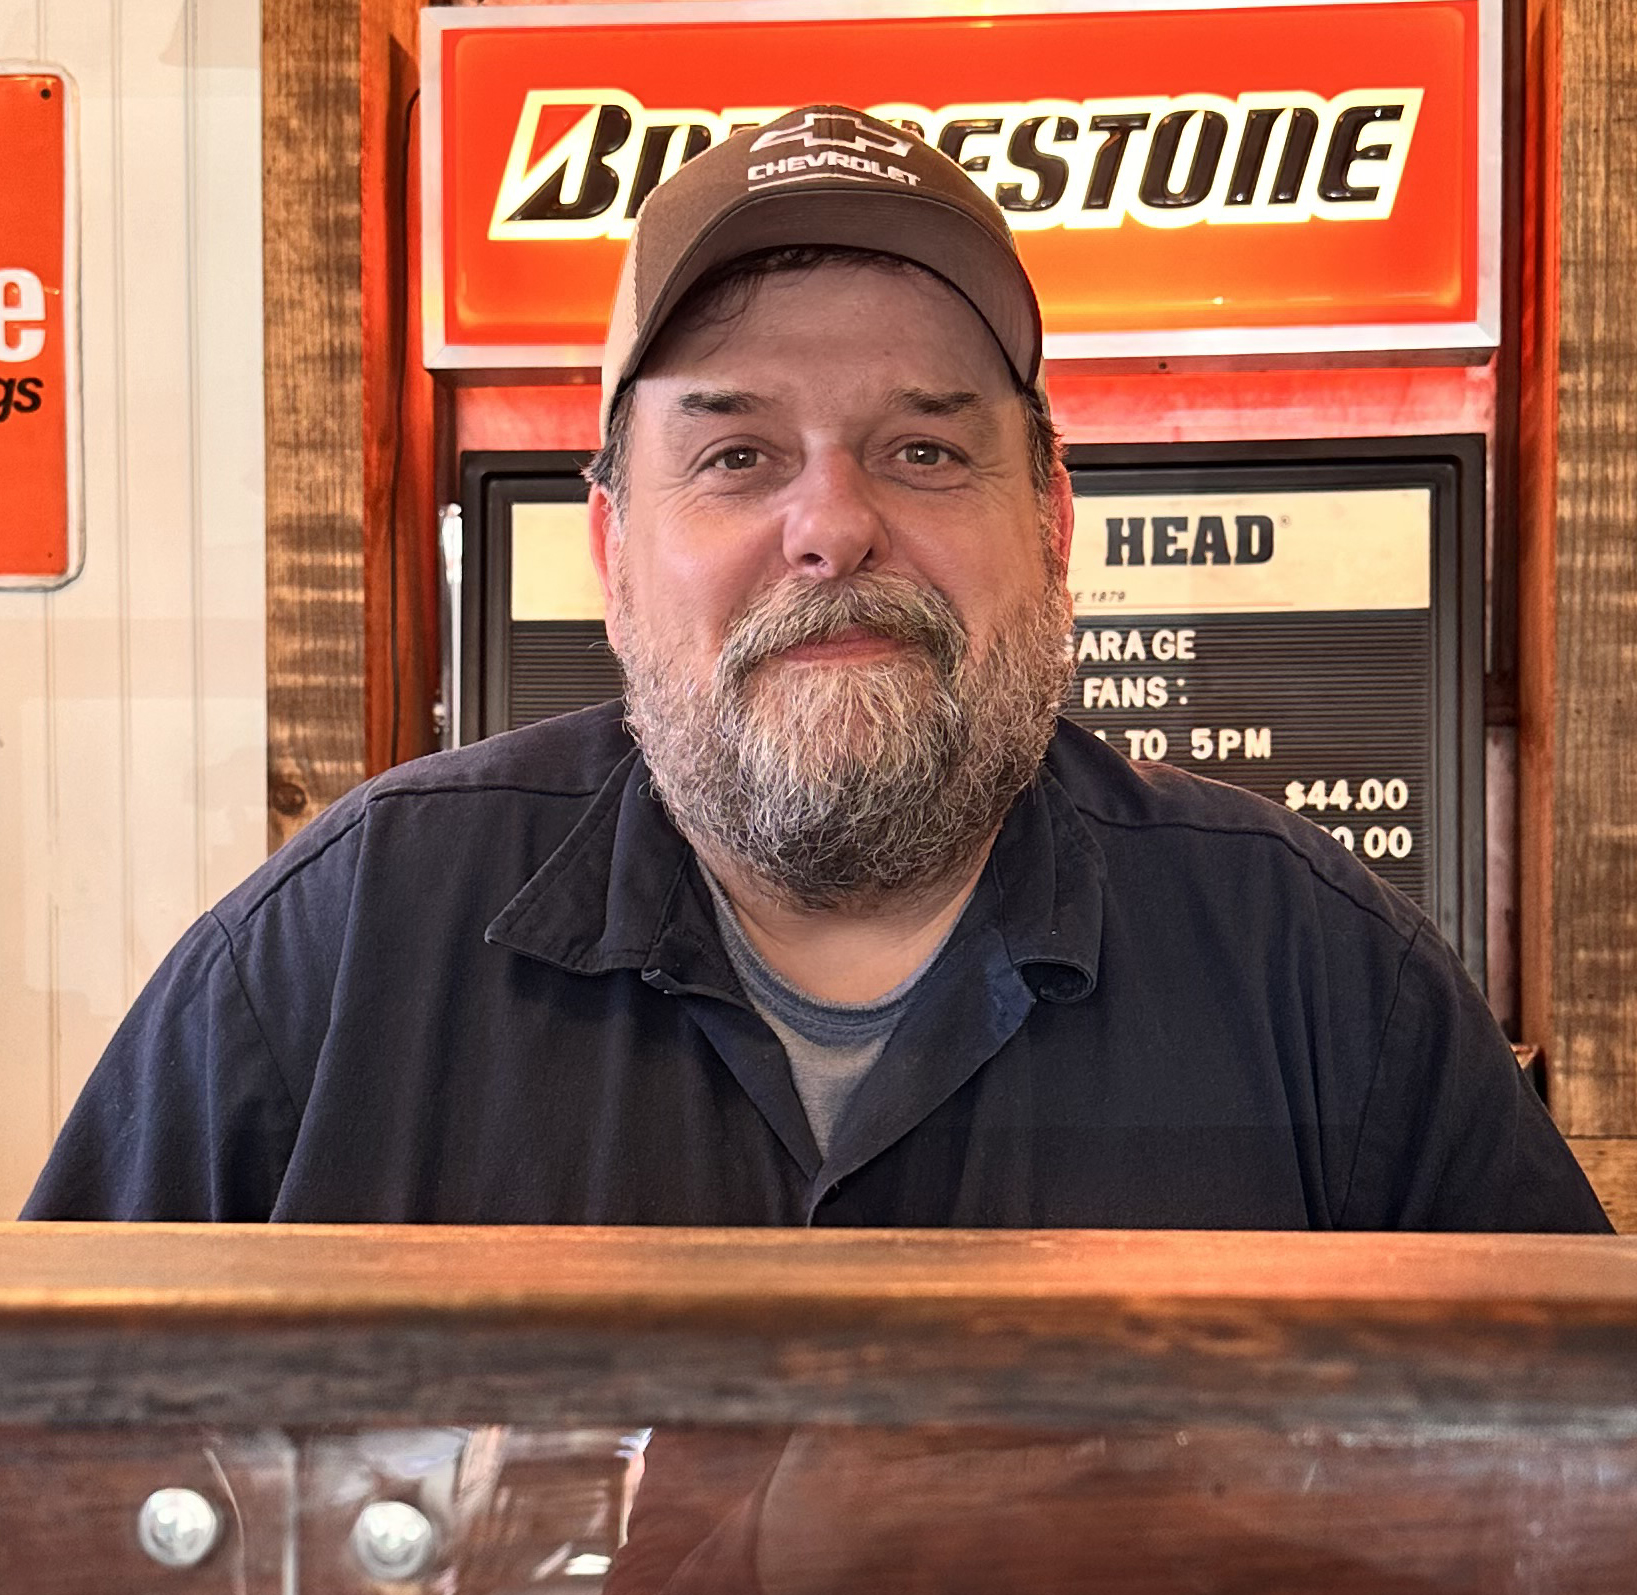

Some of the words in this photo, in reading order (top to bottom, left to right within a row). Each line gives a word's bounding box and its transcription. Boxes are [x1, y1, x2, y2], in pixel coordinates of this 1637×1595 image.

[504, 103, 1405, 221] BRESTONE
[748, 151, 921, 187] CHEVROLET
[1105, 515, 1274, 566] HEAD
[1091, 591, 1126, 602] 1879
[1124, 728, 1168, 761] TO
[1190, 728, 1272, 761] 5PM
[1285, 778, 1408, 811] $44.00
